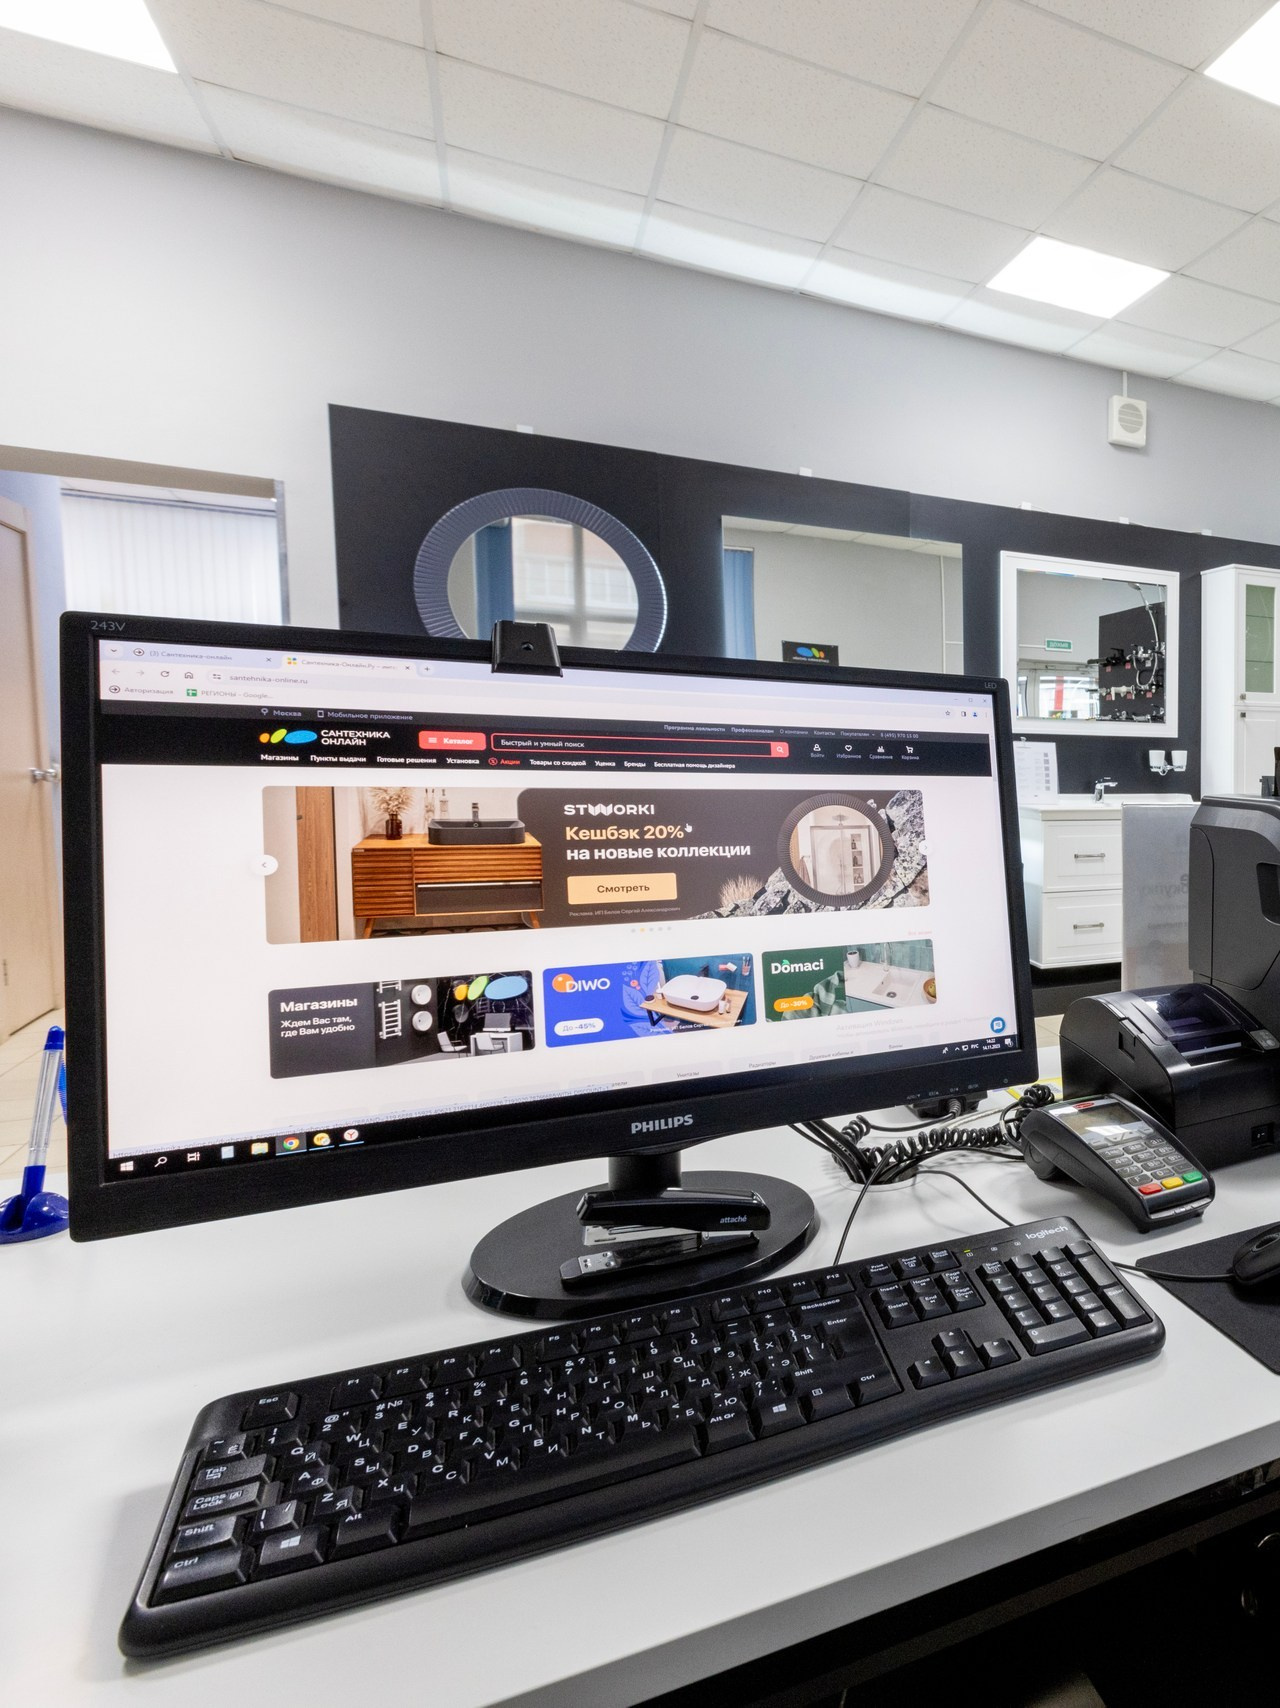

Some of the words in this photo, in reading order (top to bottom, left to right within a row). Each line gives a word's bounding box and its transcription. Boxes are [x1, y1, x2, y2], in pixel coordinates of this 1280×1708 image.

[91, 620, 126, 631] 243V
[161, 651, 232, 661] Сантехника-онлайн
[229, 675, 308, 685] santehnika-online.ru
[124, 687, 174, 695] Авторизация
[201, 689, 237, 697] РЕГИОНЫ
[327, 711, 368, 719] Мобильное
[369, 713, 413, 721] приложение
[664, 724, 695, 732] Программа
[320, 729, 391, 739] САНТЕХНИКА
[320, 737, 367, 746] ОНЛАЙН
[443, 737, 474, 745] Каталог
[501, 738, 532, 747] Быстрый
[540, 740, 563, 748] умный
[260, 754, 299, 762] Магазины
[310, 755, 338, 763] Пункты
[339, 756, 367, 764] выдачи
[446, 757, 480, 765] Установка
[500, 758, 521, 766] Акции
[529, 758, 552, 766] Товары
[624, 760, 646, 768] Бренды
[563, 803, 655, 816] STWORKI
[565, 826, 640, 841] Кешбэк
[644, 825, 684, 840] 20%
[566, 849, 590, 861] на
[594, 847, 653, 860] новые
[657, 845, 751, 859] коллекции
[596, 884, 650, 894] Смотреть
[565, 977, 610, 993] DIWO
[280, 997, 358, 1013] Магазины
[779, 1001, 789, 1010] До
[790, 999, 808, 1008] -30%
[280, 1017, 310, 1029] Ждем
[312, 1016, 330, 1026] Вас
[332, 1014, 352, 1026] там,
[280, 1028, 298, 1039] где
[299, 1026, 319, 1036] Вам
[320, 1022, 355, 1035] удобно
[562, 1024, 574, 1033] До
[748, 1061, 777, 1069] Радиаторы
[631, 1114, 694, 1134] PHILIPS
[720, 1214, 748, 1224] attaché
[1025, 1225, 1068, 1241] logitech
[801, 1298, 841, 1310] Backspace
[888, 1301, 909, 1309] Delete
[827, 1318, 847, 1326] Enter
[794, 1368, 814, 1377] Shift
[860, 1374, 875, 1382] Ctrl
[259, 1396, 279, 1405] Esc
[448, 1410, 458, 1418] R
[710, 1415, 723, 1424] Alt
[723, 1412, 736, 1420] Gr
[509, 1419, 520, 1427] G
[346, 1433, 361, 1443] W
[459, 1432, 469, 1440] F
[291, 1447, 304, 1455] Q
[408, 1444, 419, 1453] D
[354, 1458, 365, 1467] S
[206, 1466, 227, 1474] Tab
[432, 1465, 444, 1473] C
[298, 1471, 311, 1481] A
[378, 1478, 389, 1488] X
[195, 1493, 226, 1504] Caps
[322, 1493, 334, 1503] Z
[193, 1500, 223, 1510] Lock
[345, 1513, 362, 1522] Alt
[184, 1524, 214, 1535] Shift
[174, 1557, 199, 1568] Ctrl
